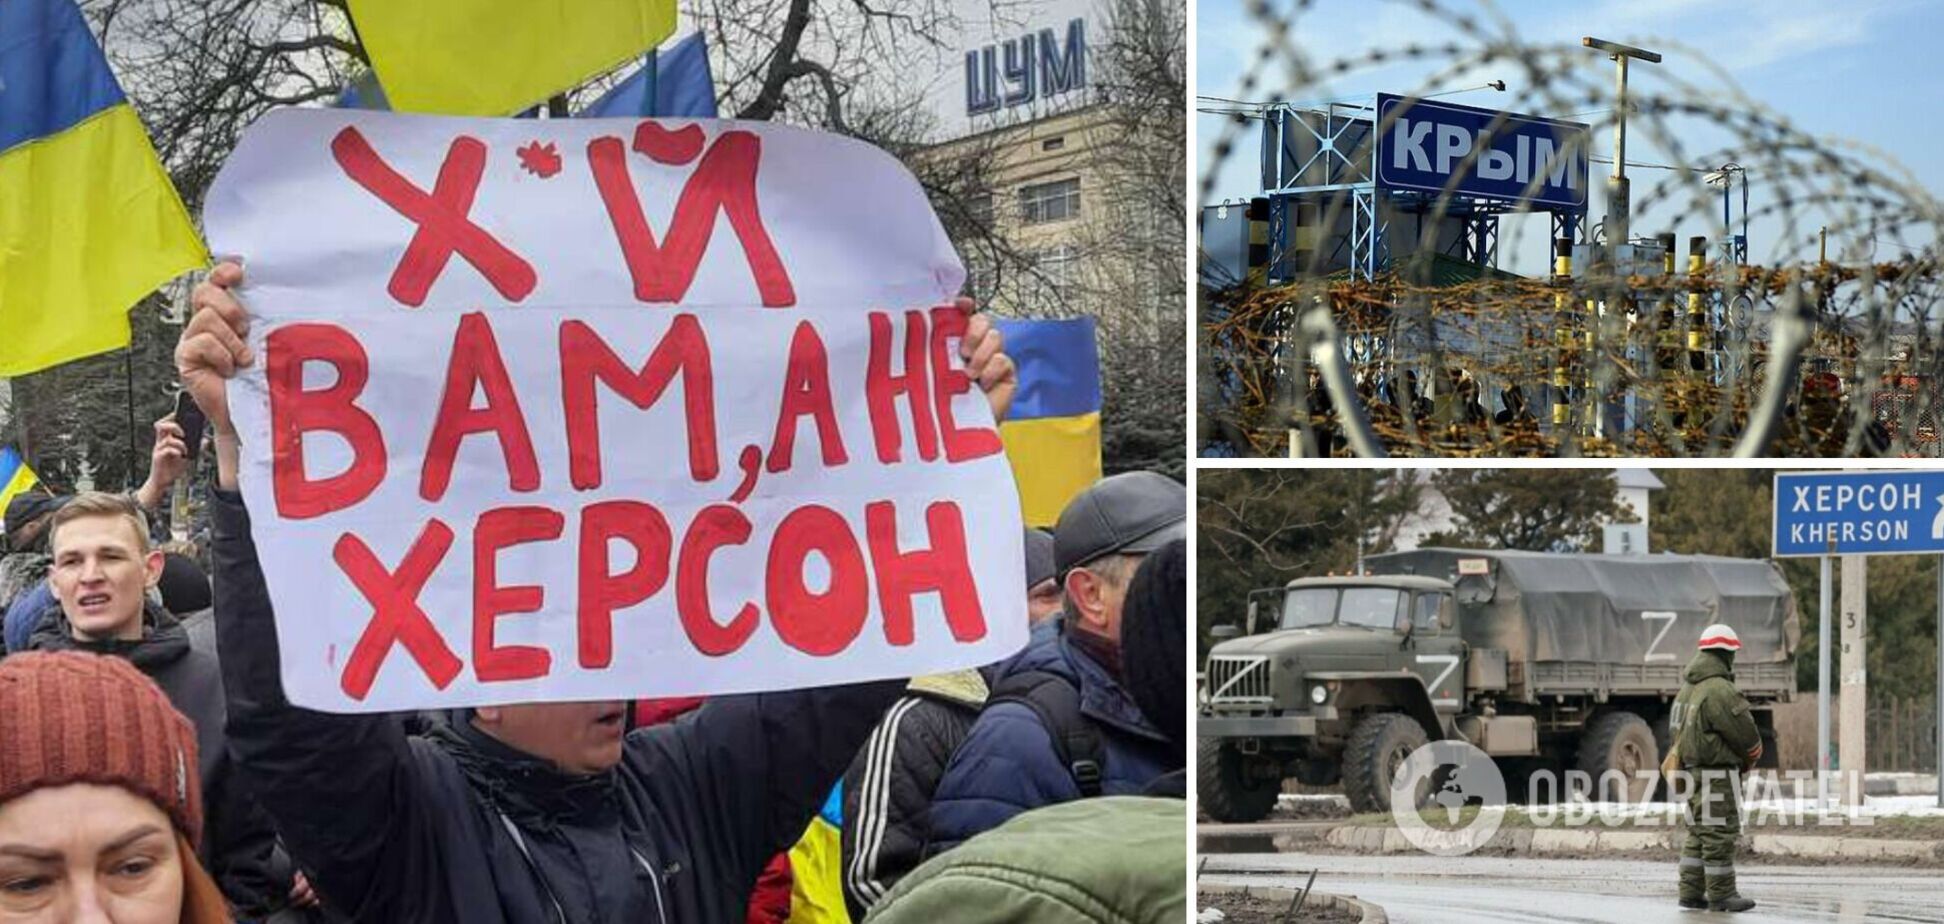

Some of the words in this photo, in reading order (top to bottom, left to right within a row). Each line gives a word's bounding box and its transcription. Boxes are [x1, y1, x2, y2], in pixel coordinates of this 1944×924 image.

[966, 17, 1085, 117] ЦУМ
[1393, 117, 1578, 189] КРЫМ
[265, 312, 763, 520] ВАМ,
[866, 305, 1004, 463] НЕ
[1792, 483, 1921, 512] ХЕРСОН
[1791, 520, 1908, 544] KHERSON
[331, 500, 988, 701] ХЕРСОН
[1641, 611, 1677, 662] Z
[1210, 655, 1273, 703] Z
[1416, 655, 1459, 706] Z
